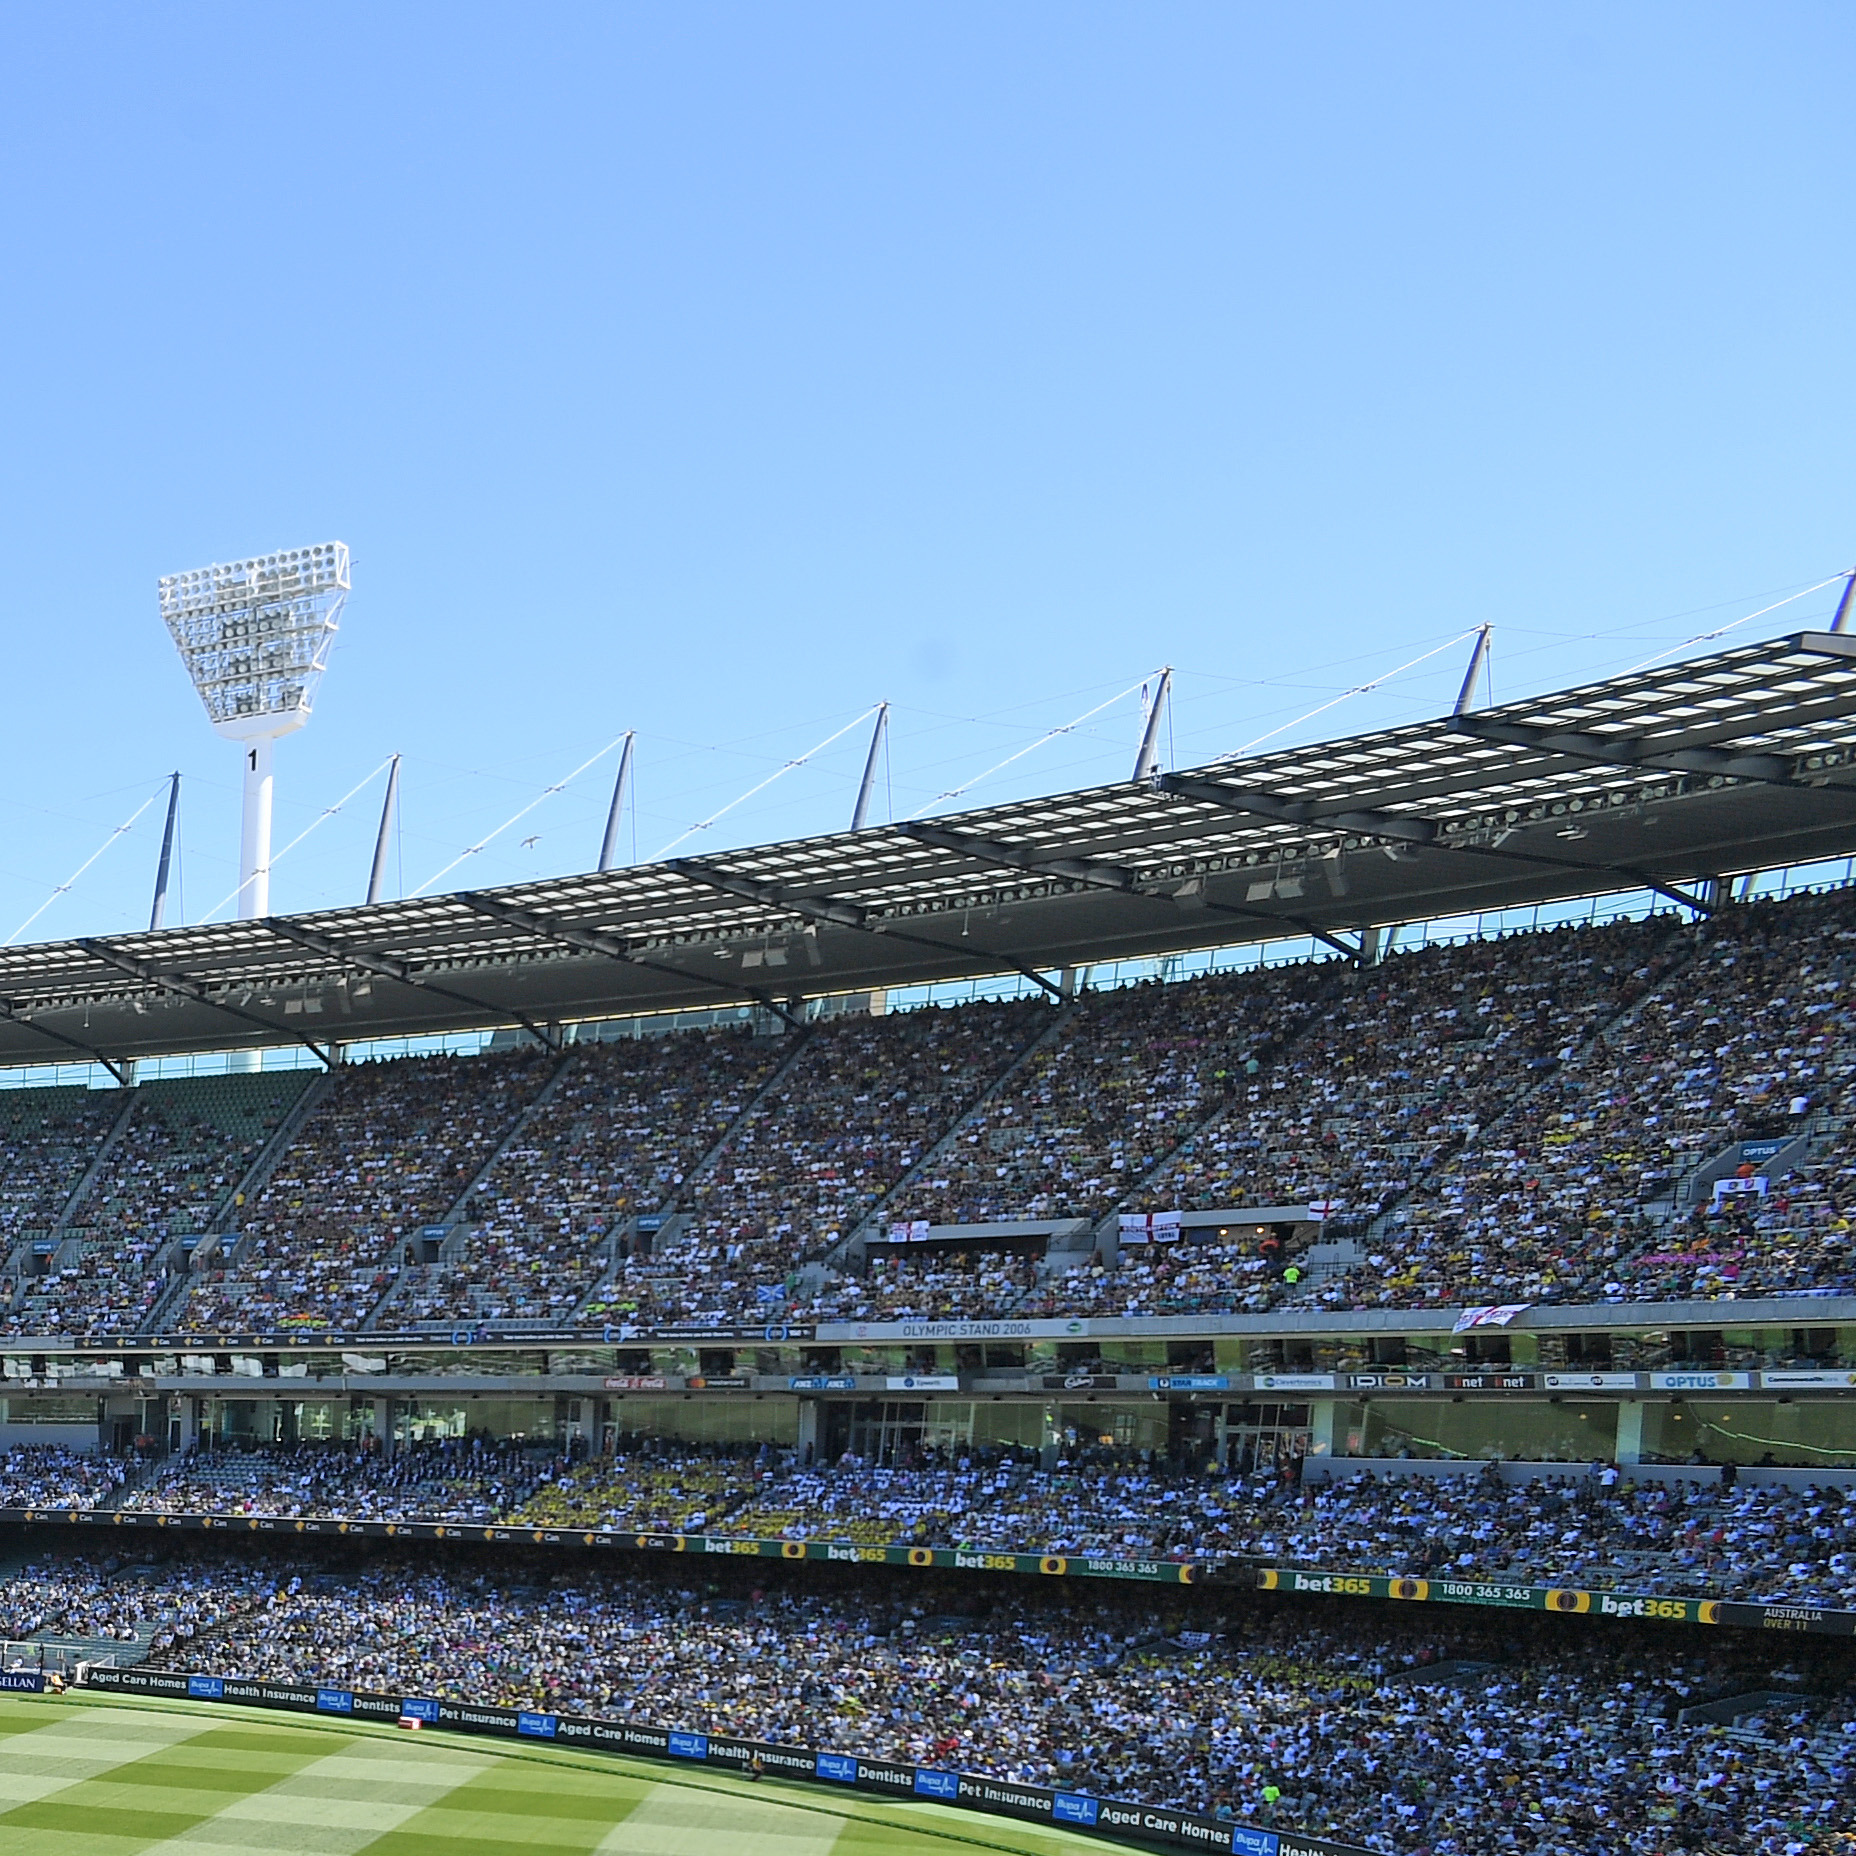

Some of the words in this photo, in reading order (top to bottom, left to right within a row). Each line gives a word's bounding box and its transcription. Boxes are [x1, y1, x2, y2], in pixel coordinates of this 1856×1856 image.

[248, 748, 258, 772] 1
[1743, 1146, 1776, 1157] OPTUS
[903, 1326, 956, 1337] OLYMPIC
[959, 1325, 1000, 1335] STAND
[1003, 1324, 1031, 1334] 2006
[1350, 1376, 1427, 1387] IDIOM
[1666, 1376, 1716, 1388] OPTUS
[705, 1539, 759, 1554] bet365
[956, 1553, 1015, 1570] bet365
[1088, 1560, 1113, 1572] 1800
[1115, 1561, 1135, 1573] 365
[1138, 1563, 1158, 1574] 365
[1294, 1574, 1371, 1595] bet365
[1442, 1583, 1472, 1598] 1800
[1476, 1585, 1502, 1600] 365
[1505, 1587, 1532, 1601] 365
[1765, 1608, 1823, 1623] AUSTRALIA
[1763, 1618, 1793, 1631] OVER
[1796, 1619, 1808, 1632] 11
[91, 1671, 119, 1686] Aged
[122, 1673, 147, 1686] Care
[150, 1675, 186, 1689] Homes
[224, 1683, 259, 1698] Health
[263, 1687, 316, 1704] Insurance
[354, 1698, 400, 1713] Dentists
[440, 1707, 459, 1720] Pet
[462, 1709, 517, 1727] Insurance
[558, 1721, 592, 1738] Aged
[593, 1726, 622, 1742] Care
[625, 1730, 666, 1747] Homes
[708, 1744, 750, 1761] Health
[753, 1747, 815, 1770] Insurance
[858, 1766, 912, 1786] Dentists
[918, 1771, 941, 1786] Bupa
[958, 1782, 980, 1797] Pet
[985, 1786, 1051, 1811] Insurance
[1057, 1798, 1080, 1813] Bupa
[1100, 1807, 1141, 1827] Aged
[1144, 1815, 1178, 1832] Care
[1181, 1821, 1230, 1844] Homes
[1237, 1832, 1260, 1847] Bupa
